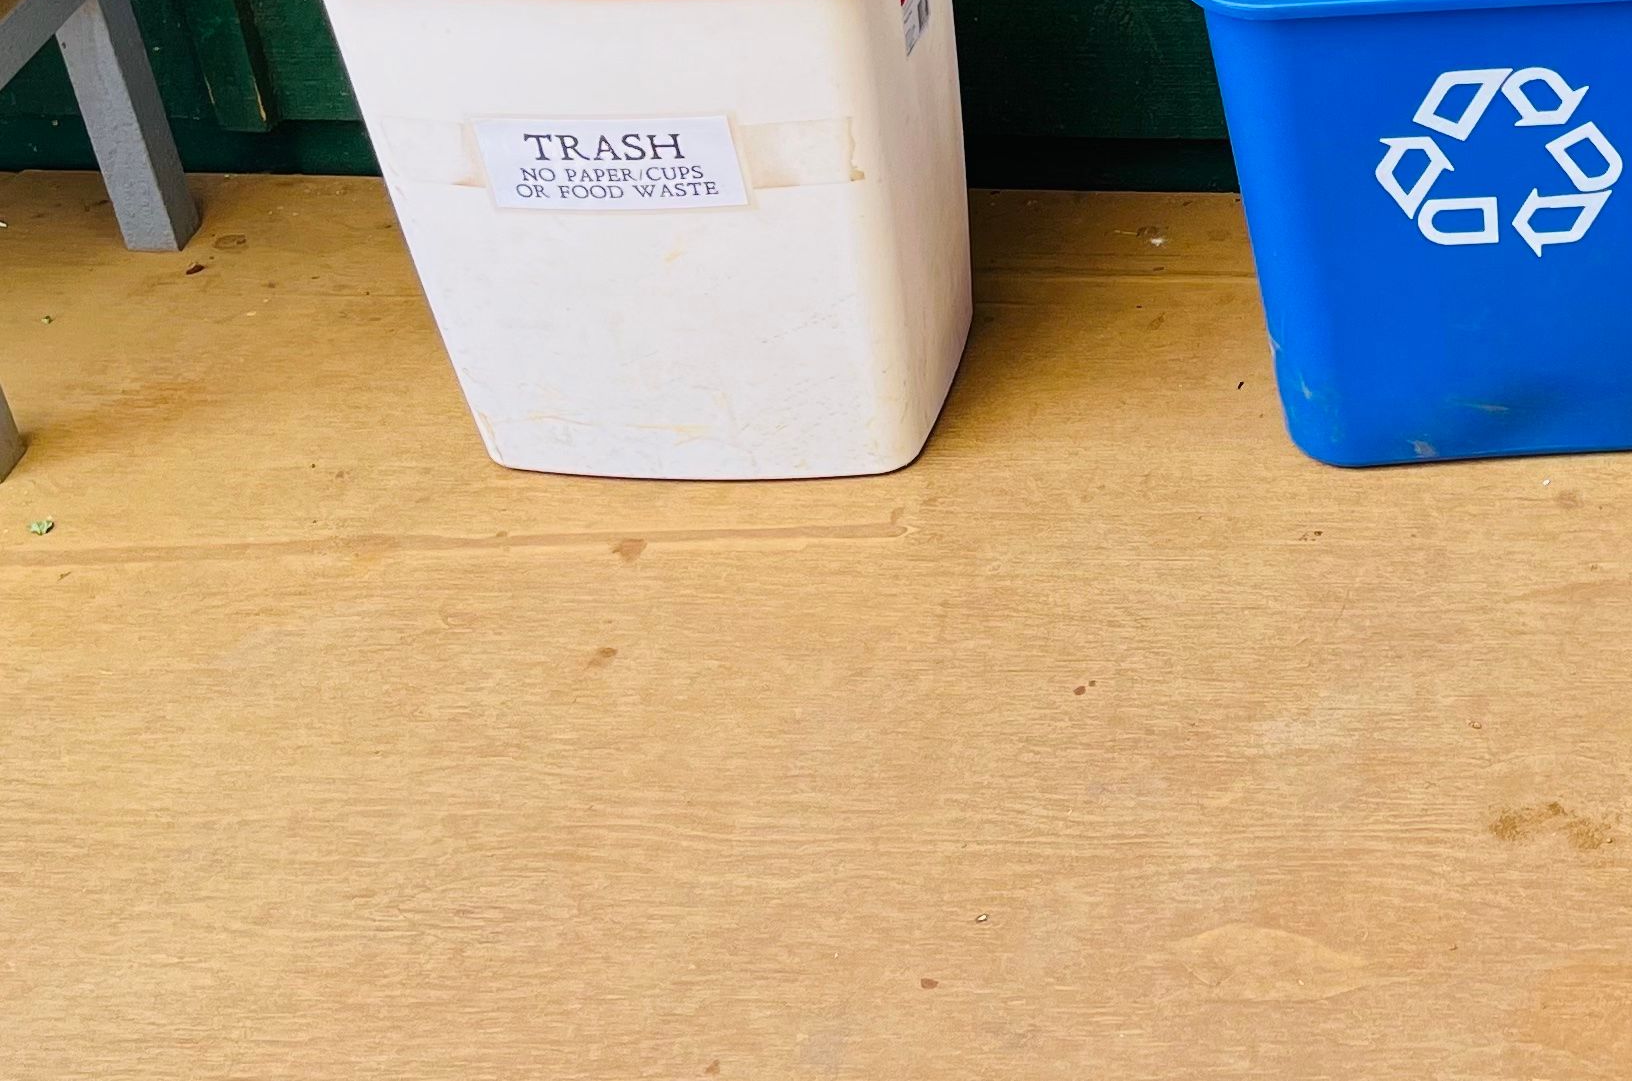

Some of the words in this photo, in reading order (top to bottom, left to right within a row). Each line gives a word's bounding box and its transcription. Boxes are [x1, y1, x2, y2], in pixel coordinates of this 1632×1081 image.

[523, 133, 685, 161] TRASH
[520, 167, 556, 182] NO
[565, 165, 705, 183] PAPER/CUPS
[516, 183, 551, 199] OR
[557, 184, 625, 200] FOOD
[634, 181, 720, 198] WASTE
